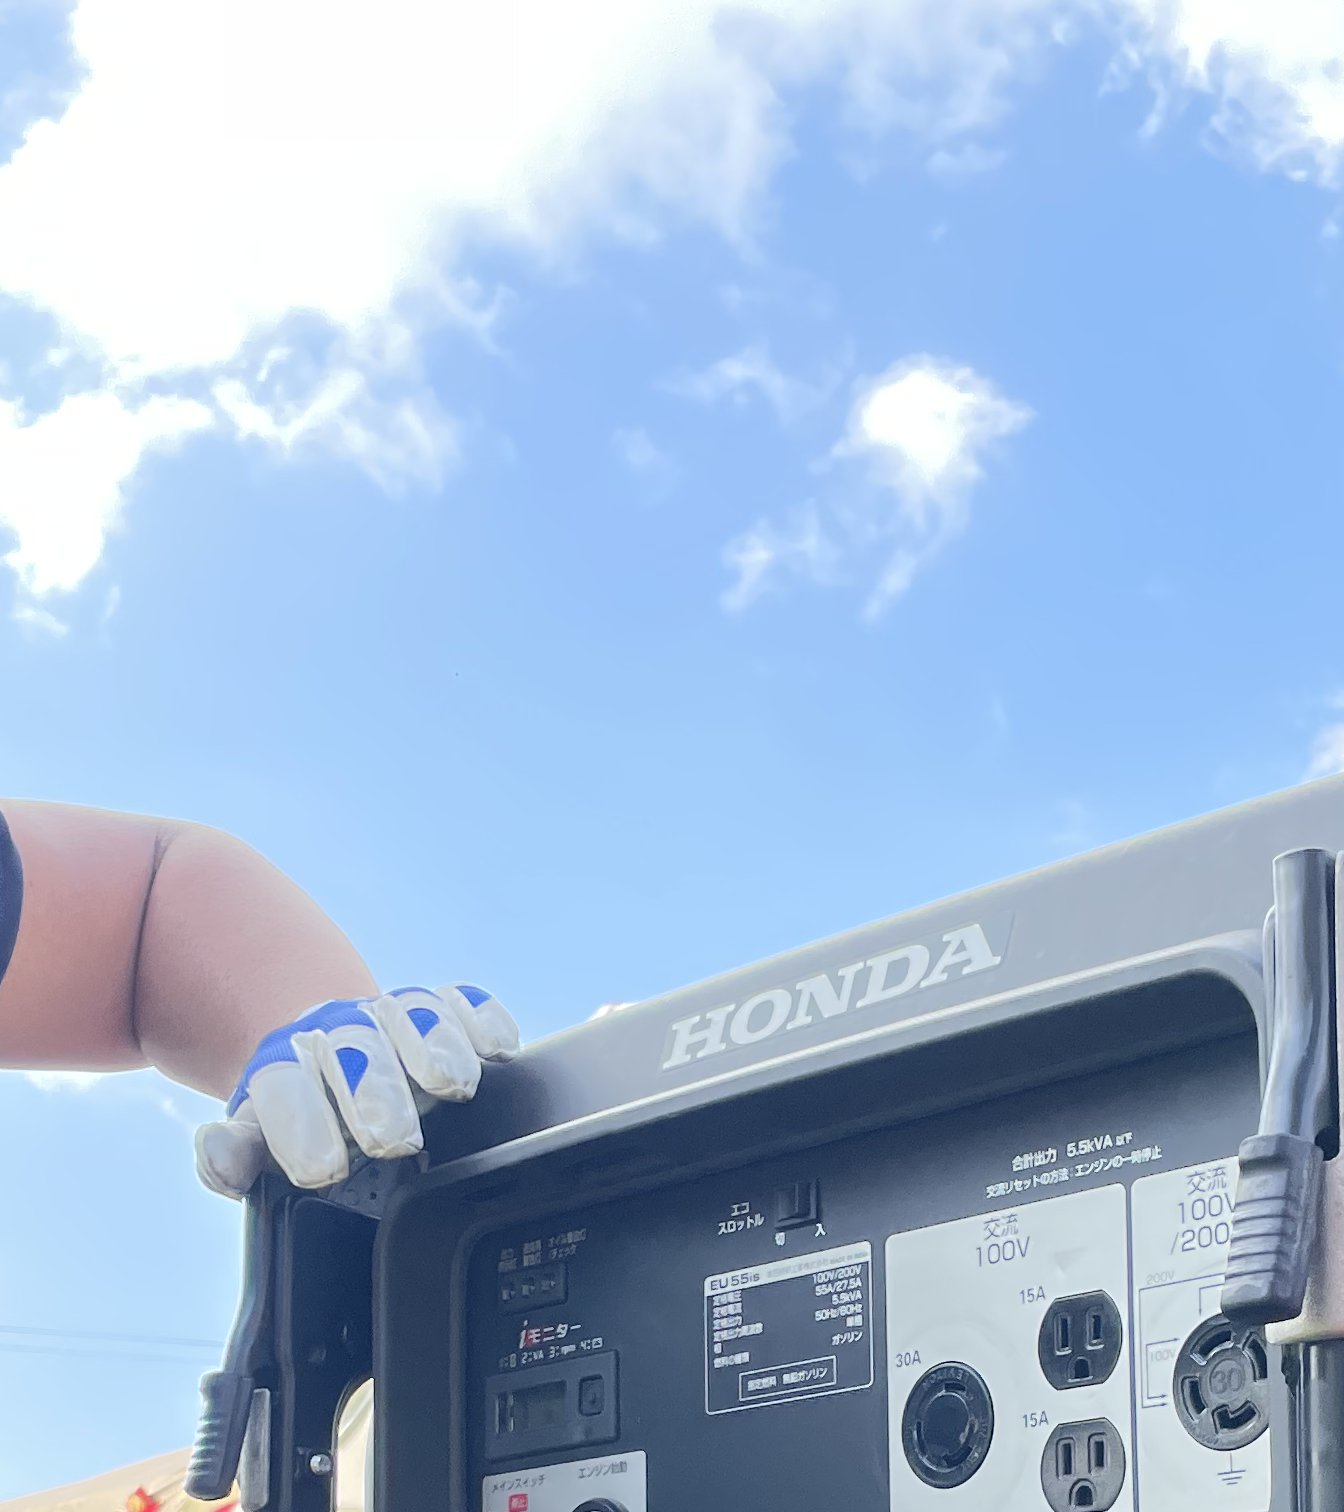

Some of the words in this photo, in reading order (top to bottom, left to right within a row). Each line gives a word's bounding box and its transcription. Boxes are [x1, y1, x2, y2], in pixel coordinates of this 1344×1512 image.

[662, 923, 1002, 1072] HONDA
[1012, 1148, 1057, 1172] 合計出力
[1066, 1134, 1113, 1158] 5.5kVA
[1186, 1166, 1227, 1197] 交流
[730, 1201, 750, 1217] エコ
[718, 1213, 765, 1236] スロットル
[983, 1213, 1019, 1241] 交流
[976, 1236, 1031, 1268] 100V
[812, 1265, 862, 1285] 100V/200V
[1146, 1270, 1176, 1286] 200V
[1018, 1285, 1047, 1306] 15A
[895, 1350, 922, 1368] 30A
[1211, 1368, 1243, 1396] 30
[1022, 1410, 1050, 1429] 15A
